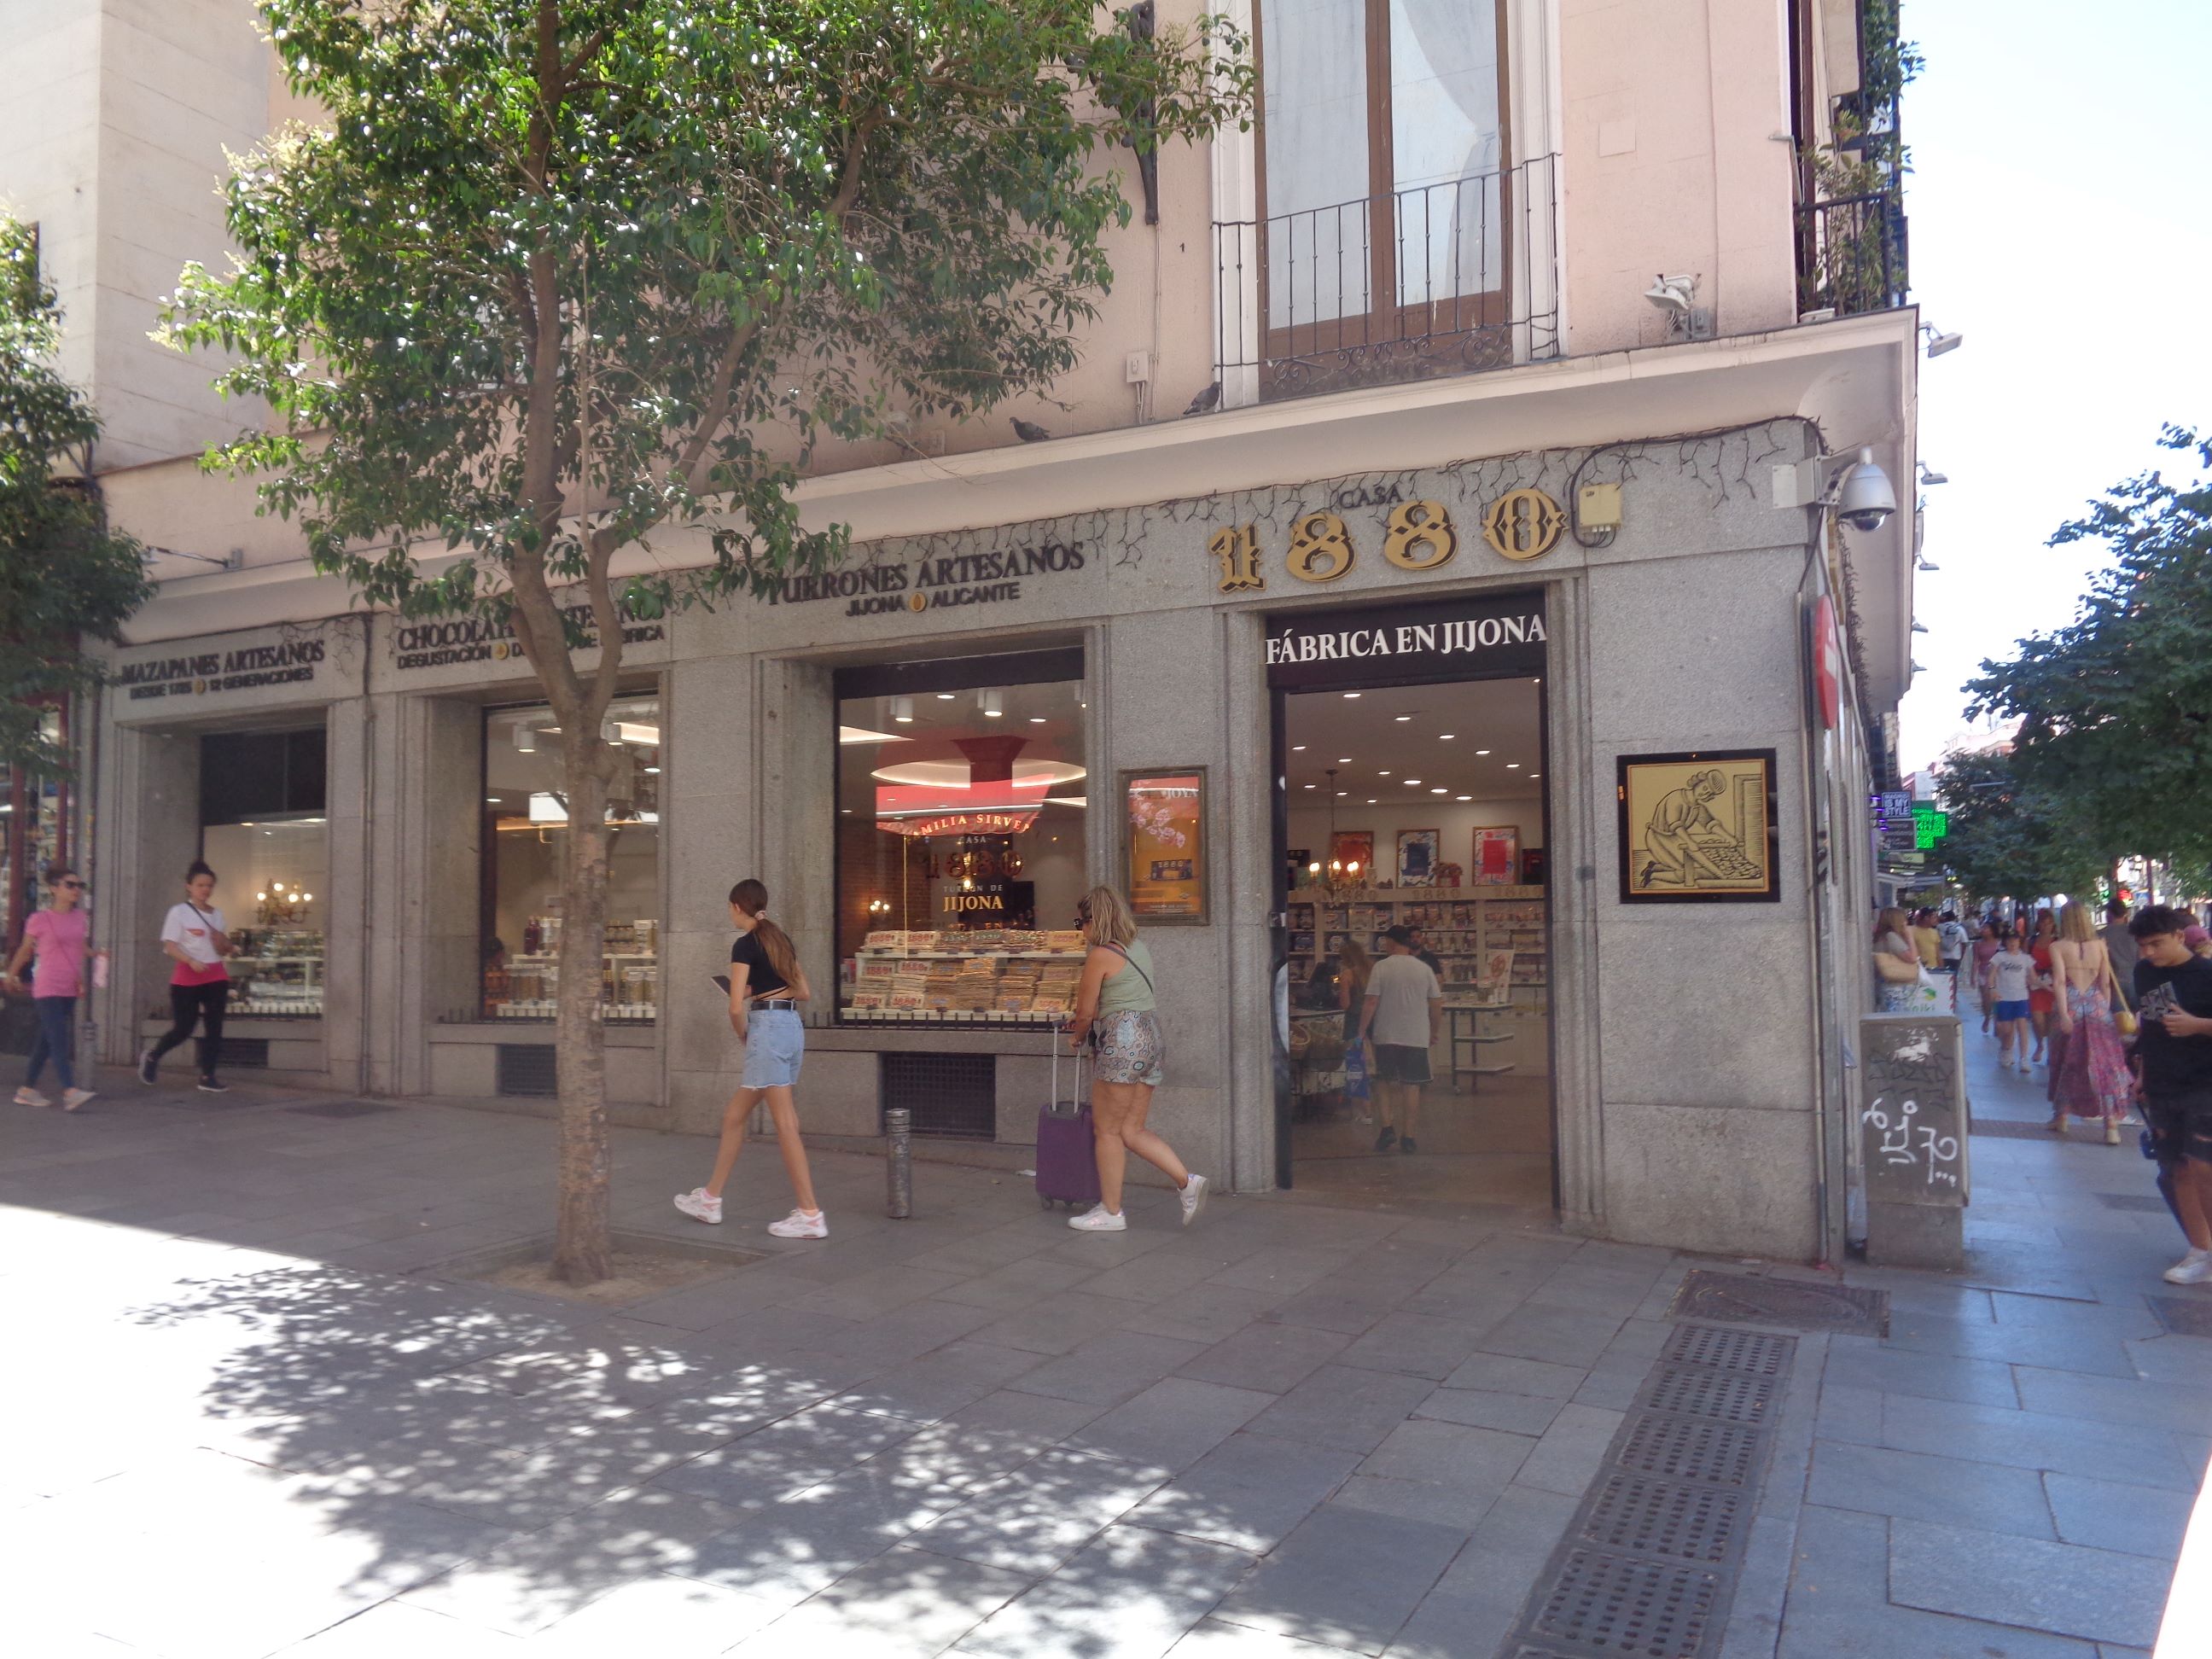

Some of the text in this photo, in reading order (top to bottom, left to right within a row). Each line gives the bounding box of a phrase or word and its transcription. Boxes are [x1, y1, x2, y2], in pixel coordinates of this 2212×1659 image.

[1338, 486, 1404, 509] CASA
[1208, 488, 1569, 594] 1880
[915, 541, 1085, 589] ARTESANOS
[845, 581, 1022, 617] JIJONA ALICANTE
[397, 643, 492, 670] DEGUSTACIÓN
[1265, 614, 1547, 665] FÁBRICA EN JIJONA
[120, 639, 325, 686] MAZAPANES ARTESANOS
[1884, 806, 1911, 816] STYLE
[943, 895, 1004, 912] JIJONA
